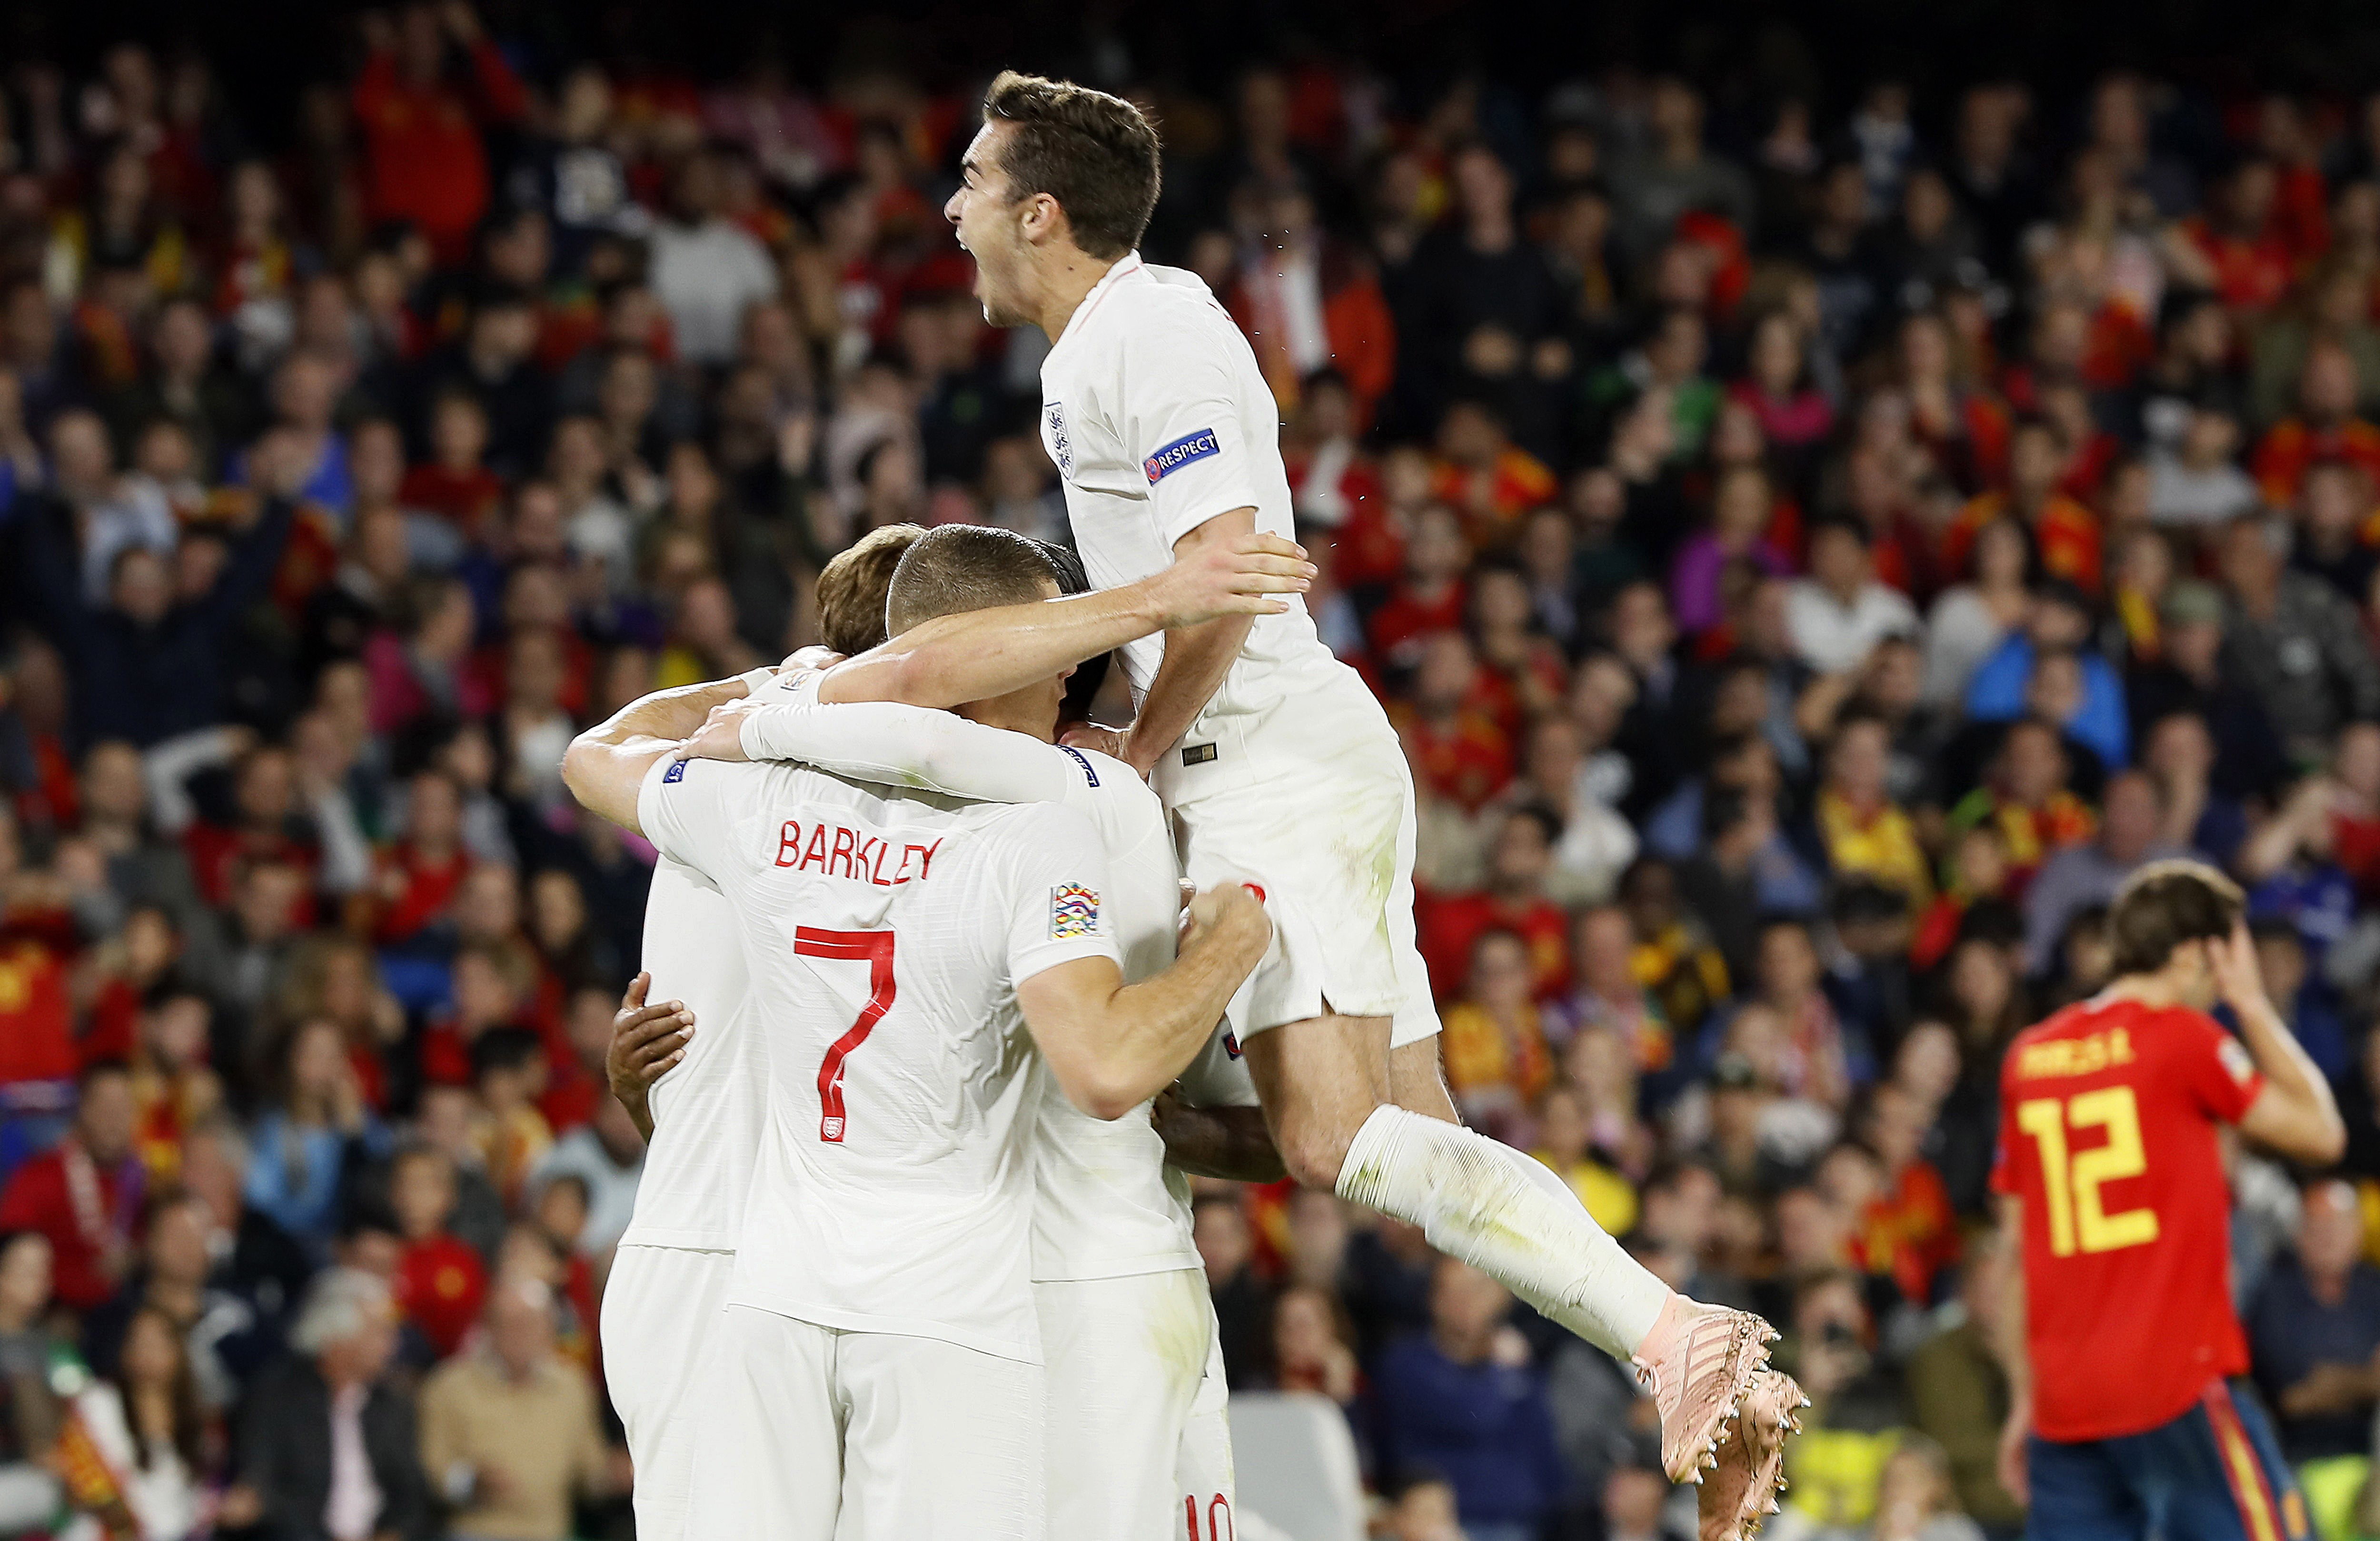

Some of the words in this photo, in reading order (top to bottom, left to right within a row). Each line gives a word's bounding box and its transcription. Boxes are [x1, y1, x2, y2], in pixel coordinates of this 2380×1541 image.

[1158, 434, 1215, 470] RESPECT
[775, 820, 943, 886] BARKLEY
[794, 925, 896, 1143] 7
[2017, 1085, 2161, 1258] 12
